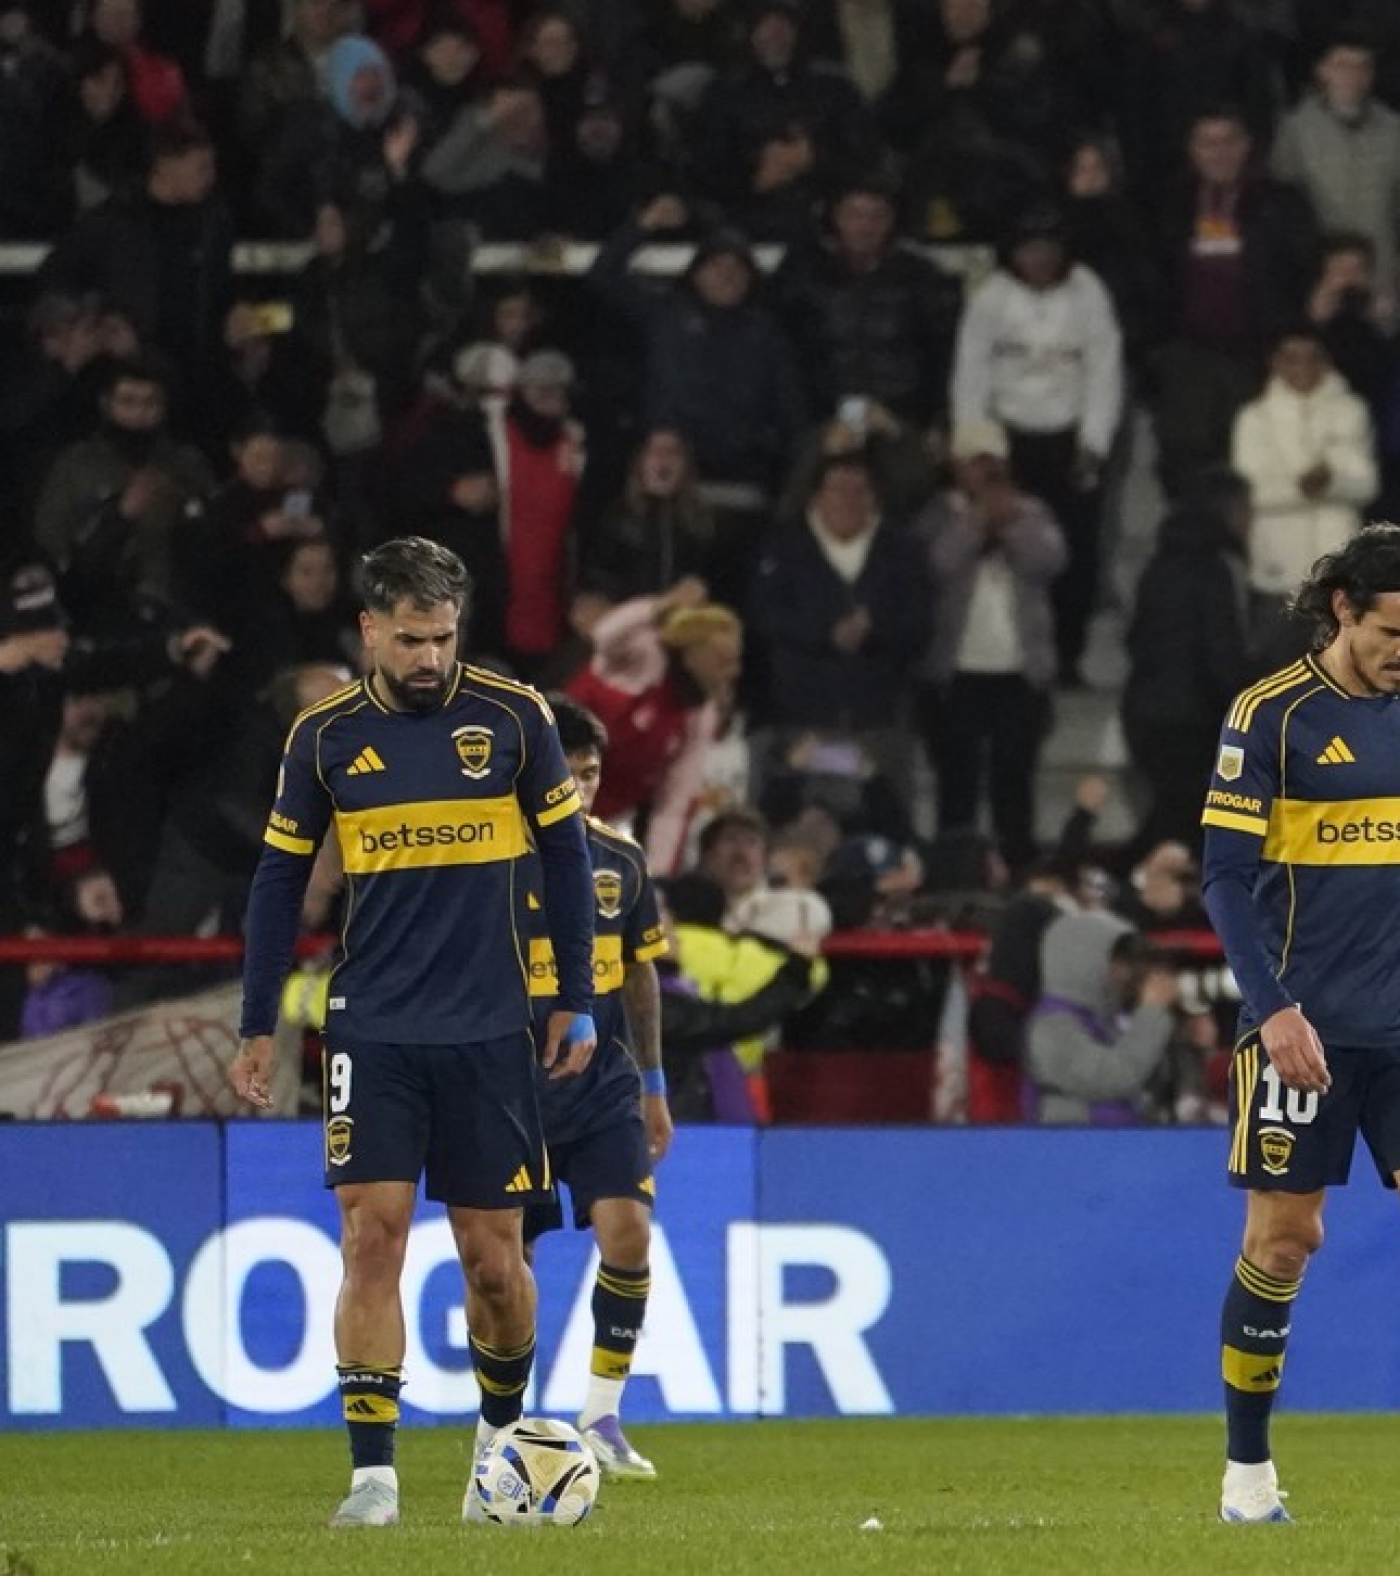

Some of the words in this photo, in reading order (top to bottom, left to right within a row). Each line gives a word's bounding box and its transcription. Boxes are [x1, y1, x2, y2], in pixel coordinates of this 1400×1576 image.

[359, 822, 494, 853] betsson
[330, 1052, 353, 1112] 9
[5, 1215, 896, 1415] ROGAR
